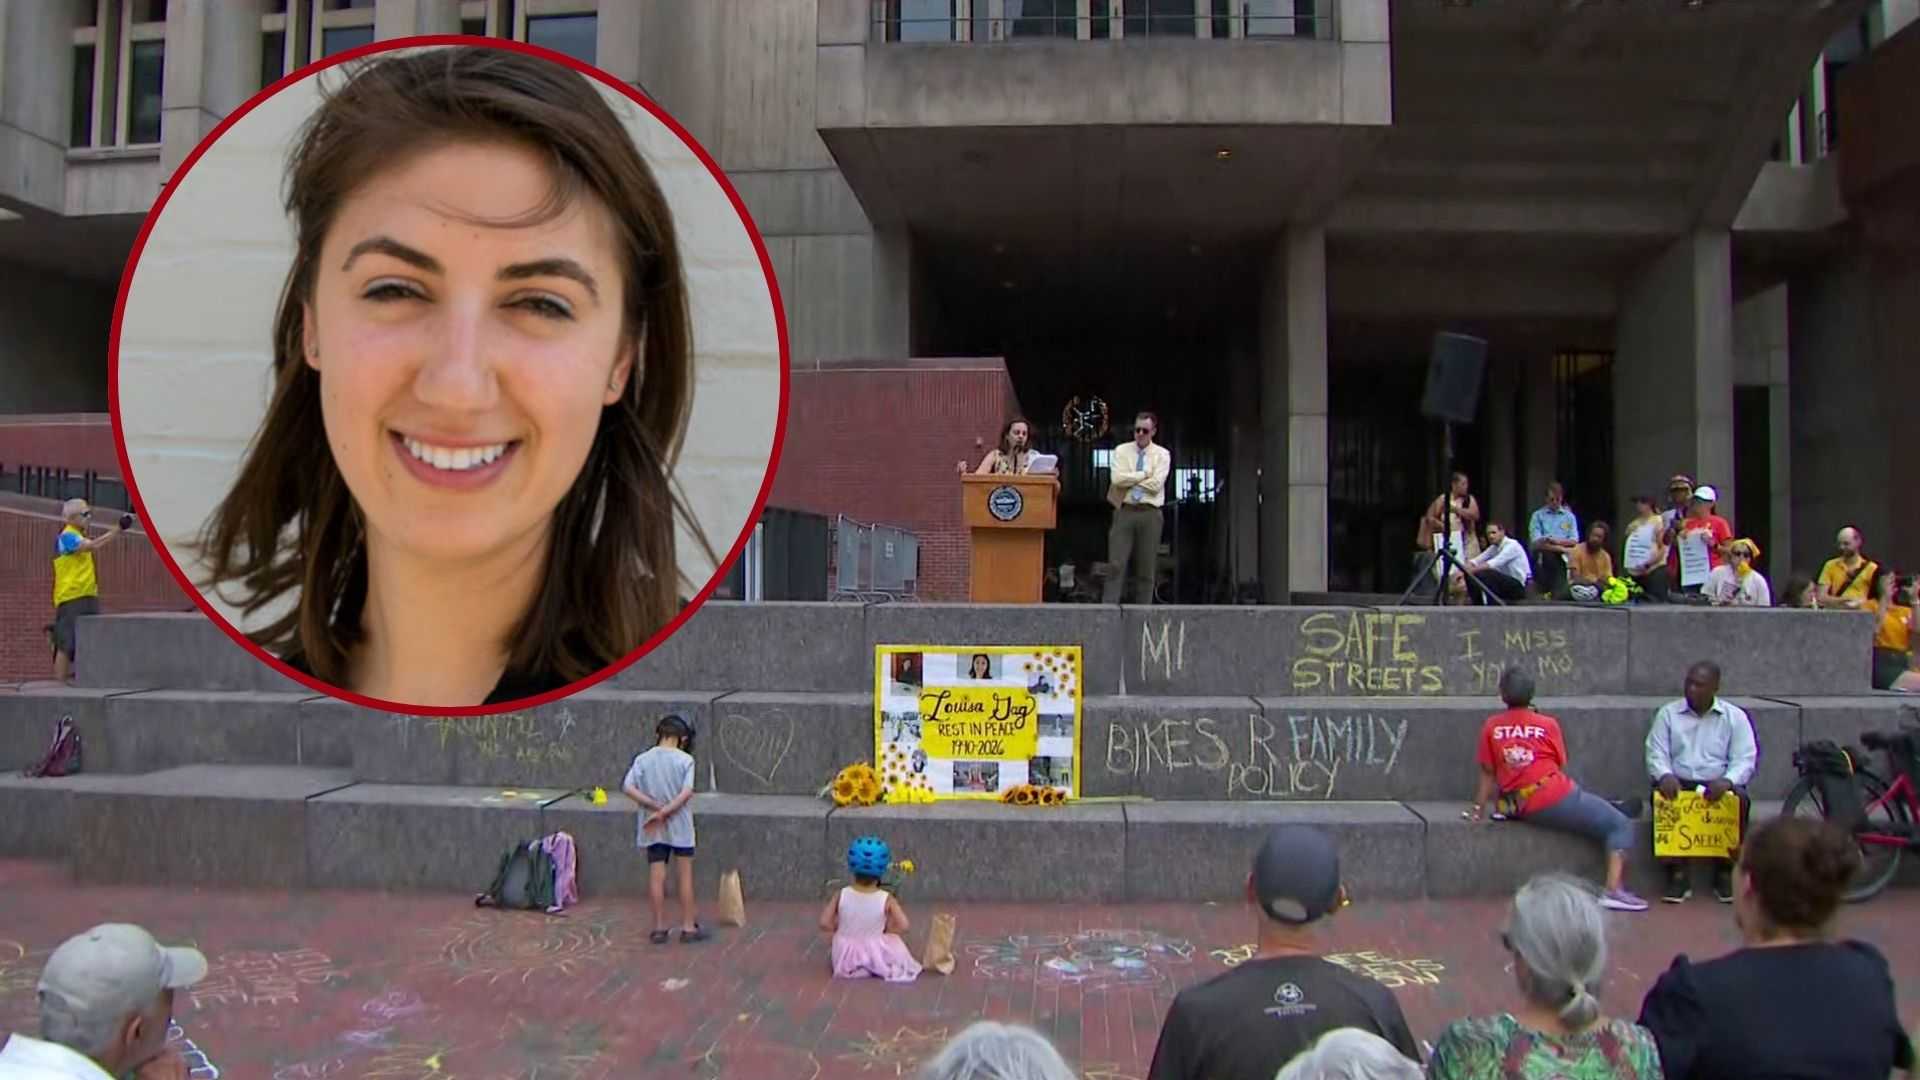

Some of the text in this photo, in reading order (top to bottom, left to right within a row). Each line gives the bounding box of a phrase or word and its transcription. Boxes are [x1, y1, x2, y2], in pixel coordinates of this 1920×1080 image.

[1300, 610, 1425, 666] SAFE
[1456, 628, 1568, 659] I MISS
[1292, 658, 1444, 693] STREETS
[1537, 653, 1573, 679] MO
[920, 690, 985, 722] Louisa
[938, 721, 1016, 737] REST IN PEACE
[1105, 717, 1230, 777] BIKES
[1287, 713, 1409, 776] FAMILY
[1493, 725, 1545, 740] STAFF
[1227, 756, 1341, 799] POLICY
